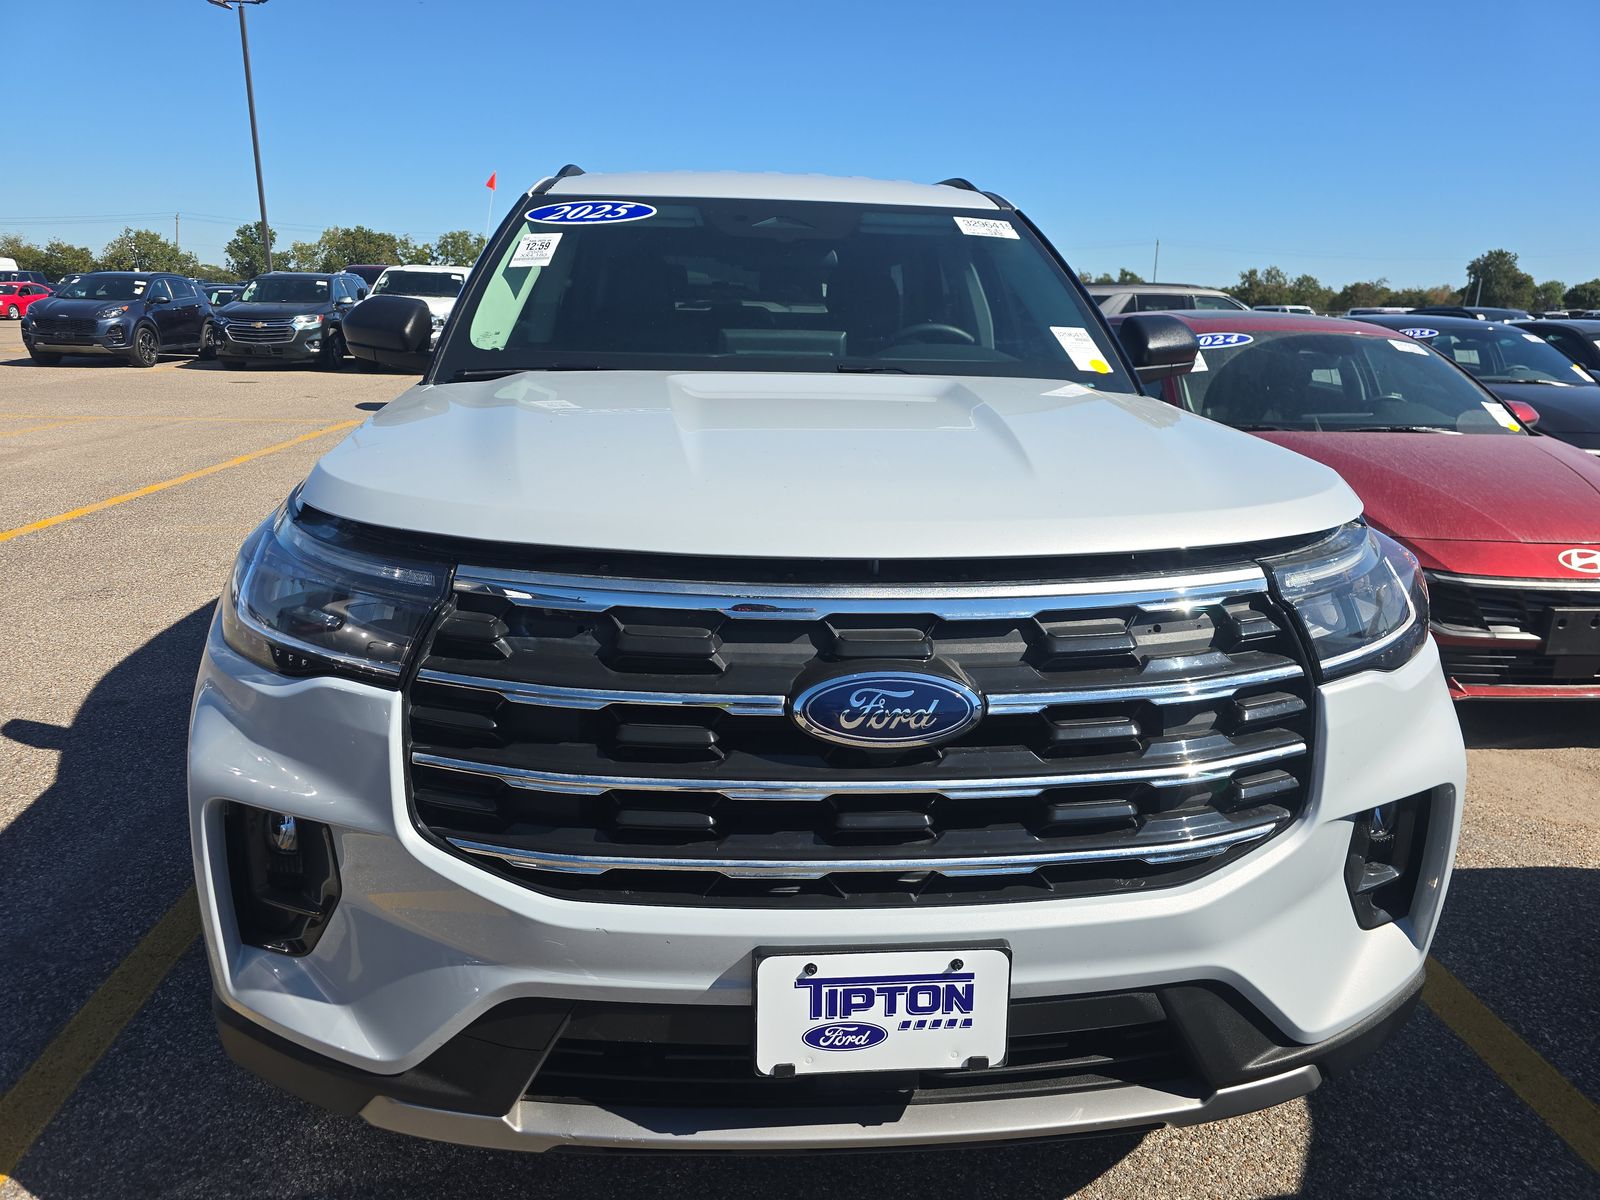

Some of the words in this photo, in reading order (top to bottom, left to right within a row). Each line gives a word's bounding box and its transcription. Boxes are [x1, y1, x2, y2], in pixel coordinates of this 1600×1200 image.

[541, 204, 637, 220] 2025
[525, 241, 551, 251] 12:59
[1199, 335, 1239, 346] 024
[839, 688, 940, 730] Ford
[794, 972, 976, 1020] TIPTON
[819, 1026, 871, 1047] Ford
